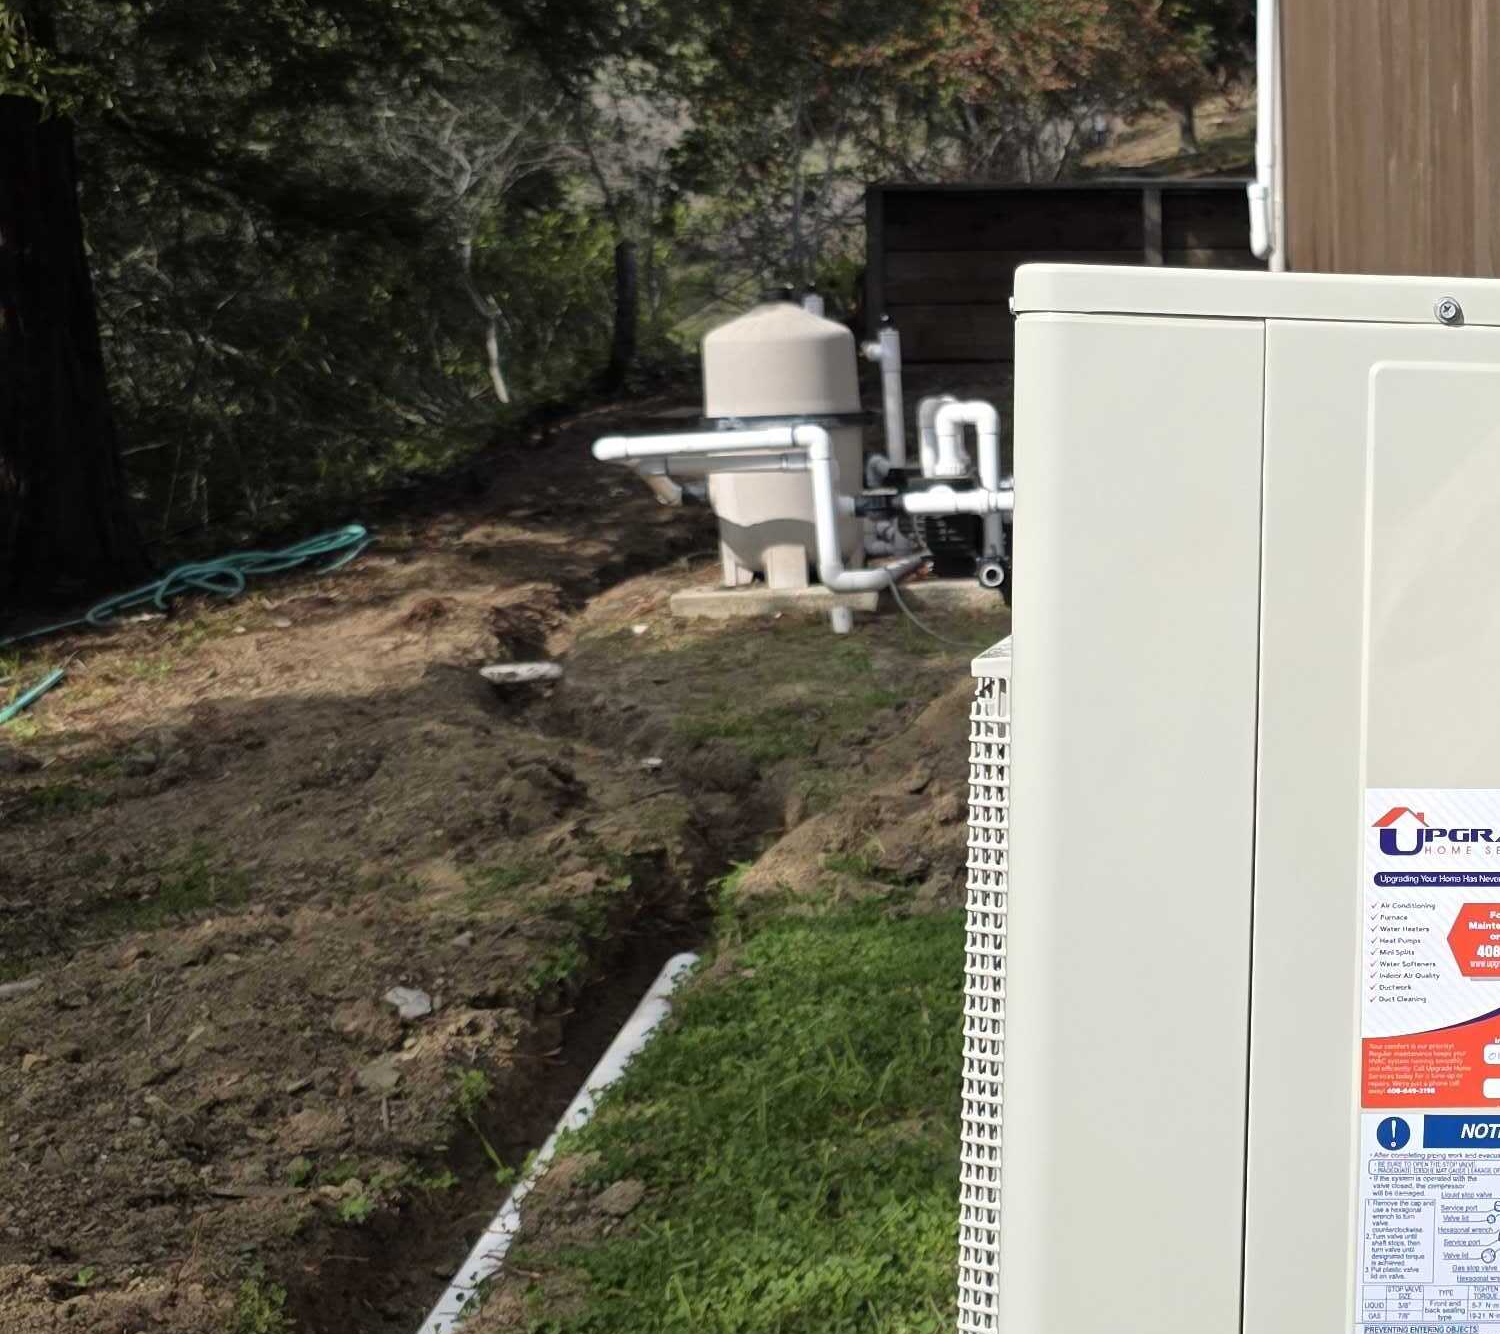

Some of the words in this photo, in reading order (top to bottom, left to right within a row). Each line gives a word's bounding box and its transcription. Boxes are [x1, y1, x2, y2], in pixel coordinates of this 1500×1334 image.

[1424, 846, 1472, 855] HOME
[1380, 875, 1418, 884] Upgrading
[1421, 875, 1437, 884] Your
[1439, 875, 1460, 884] Home
[1463, 875, 1478, 884] Has
[1479, 875, 1500, 884] Never
